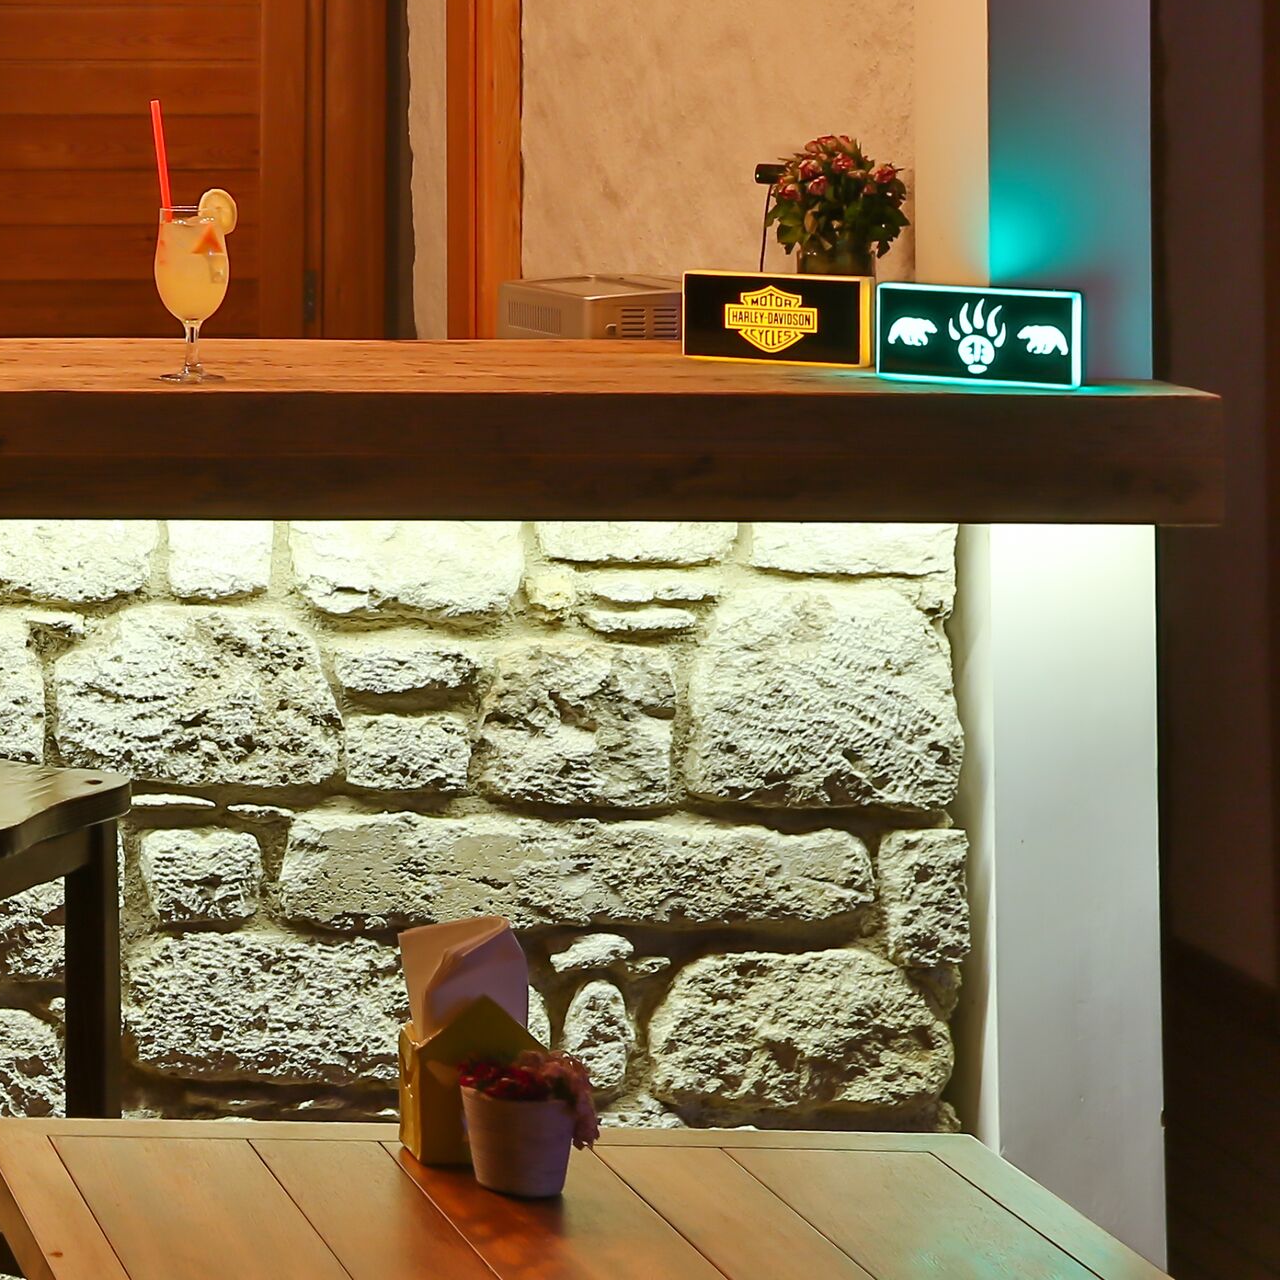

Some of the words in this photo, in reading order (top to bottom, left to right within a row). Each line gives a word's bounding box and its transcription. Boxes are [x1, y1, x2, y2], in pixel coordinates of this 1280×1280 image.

[751, 293, 792, 308] MOTOR
[732, 310, 811, 326] HARLEY-DAVIDSON
[750, 329, 792, 346] CYCLES
